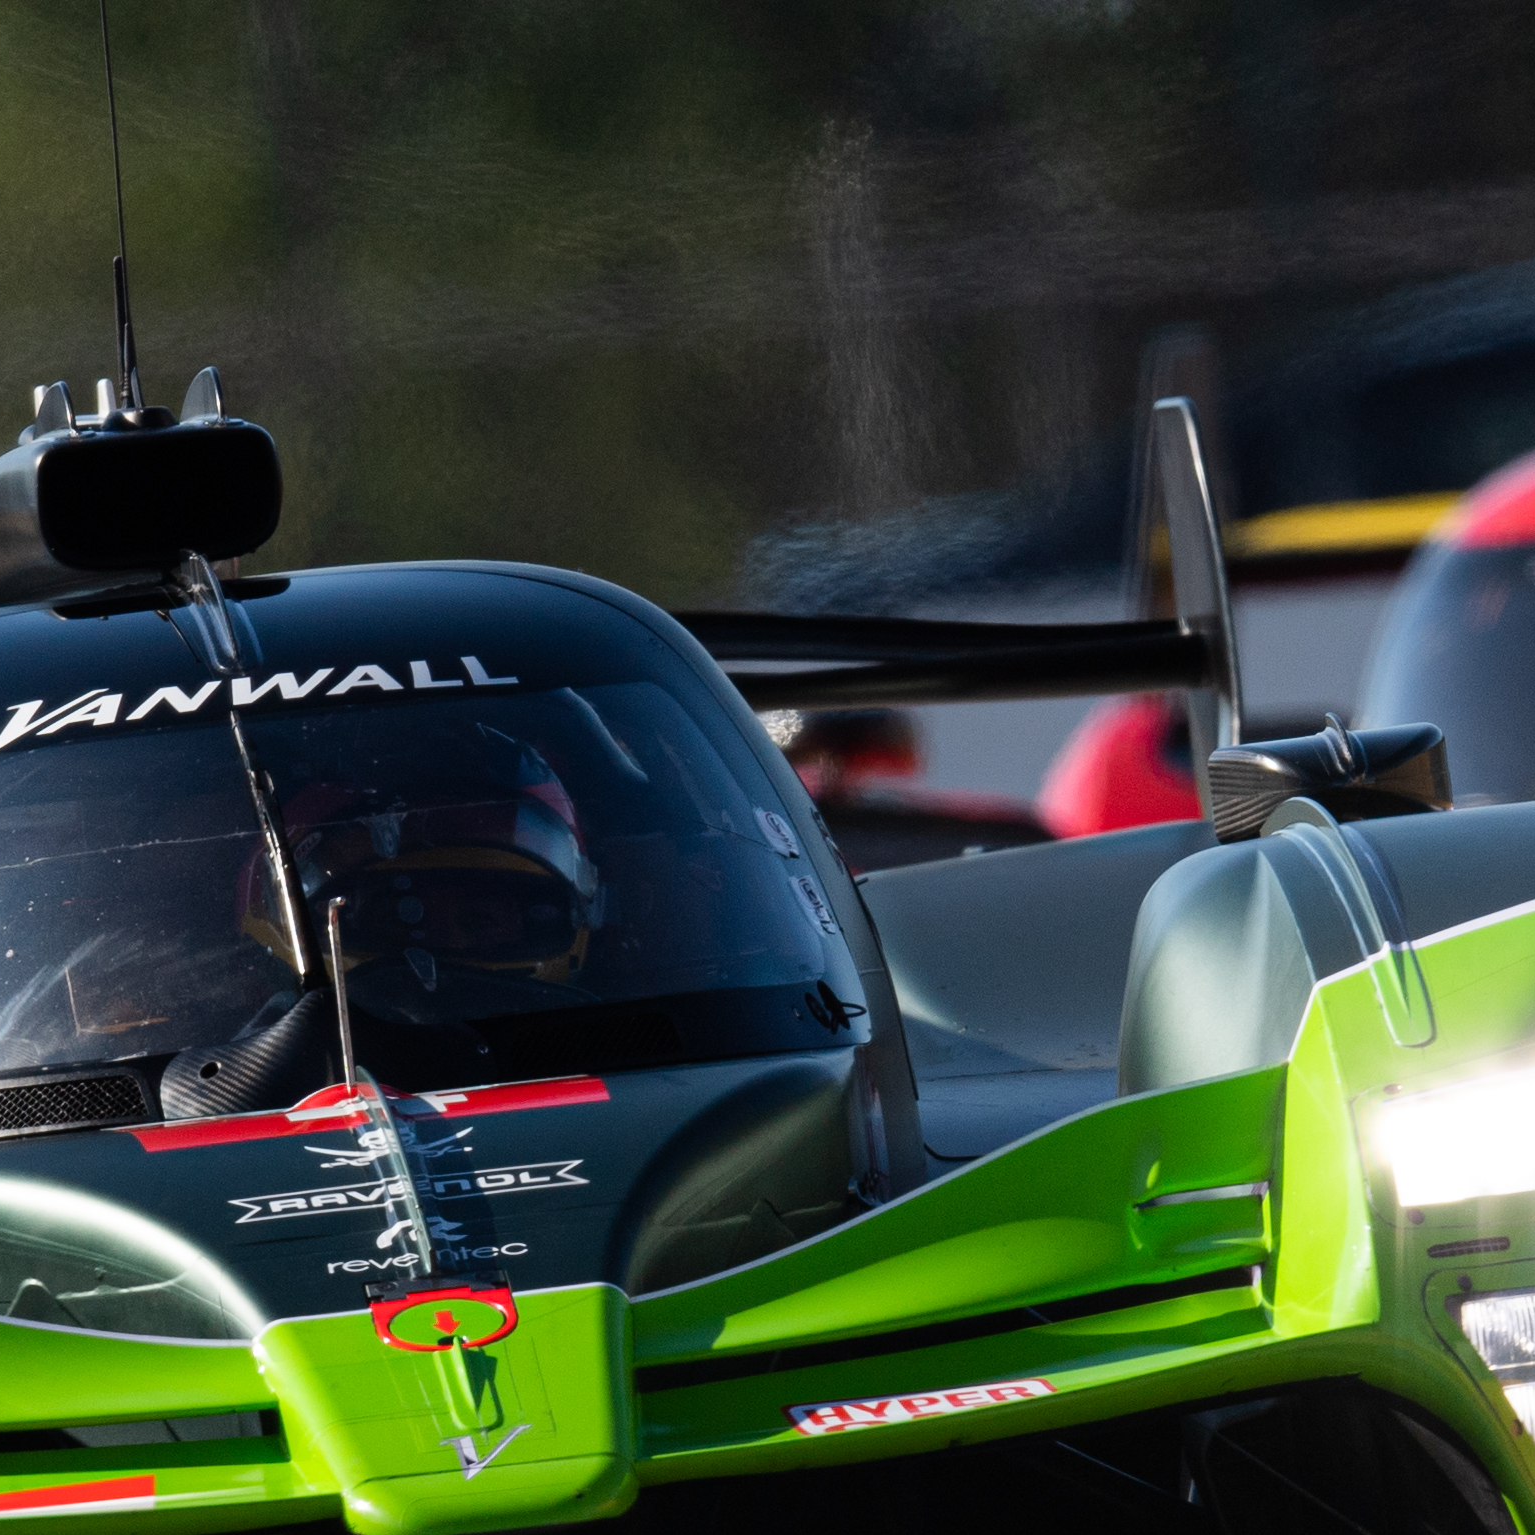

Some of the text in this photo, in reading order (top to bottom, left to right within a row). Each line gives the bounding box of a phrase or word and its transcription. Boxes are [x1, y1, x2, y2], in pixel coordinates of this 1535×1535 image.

[269, 1170, 551, 1214] RAVENOL
[327, 1242, 528, 1274] reventec
[803, 1385, 1038, 1427] HYPER
